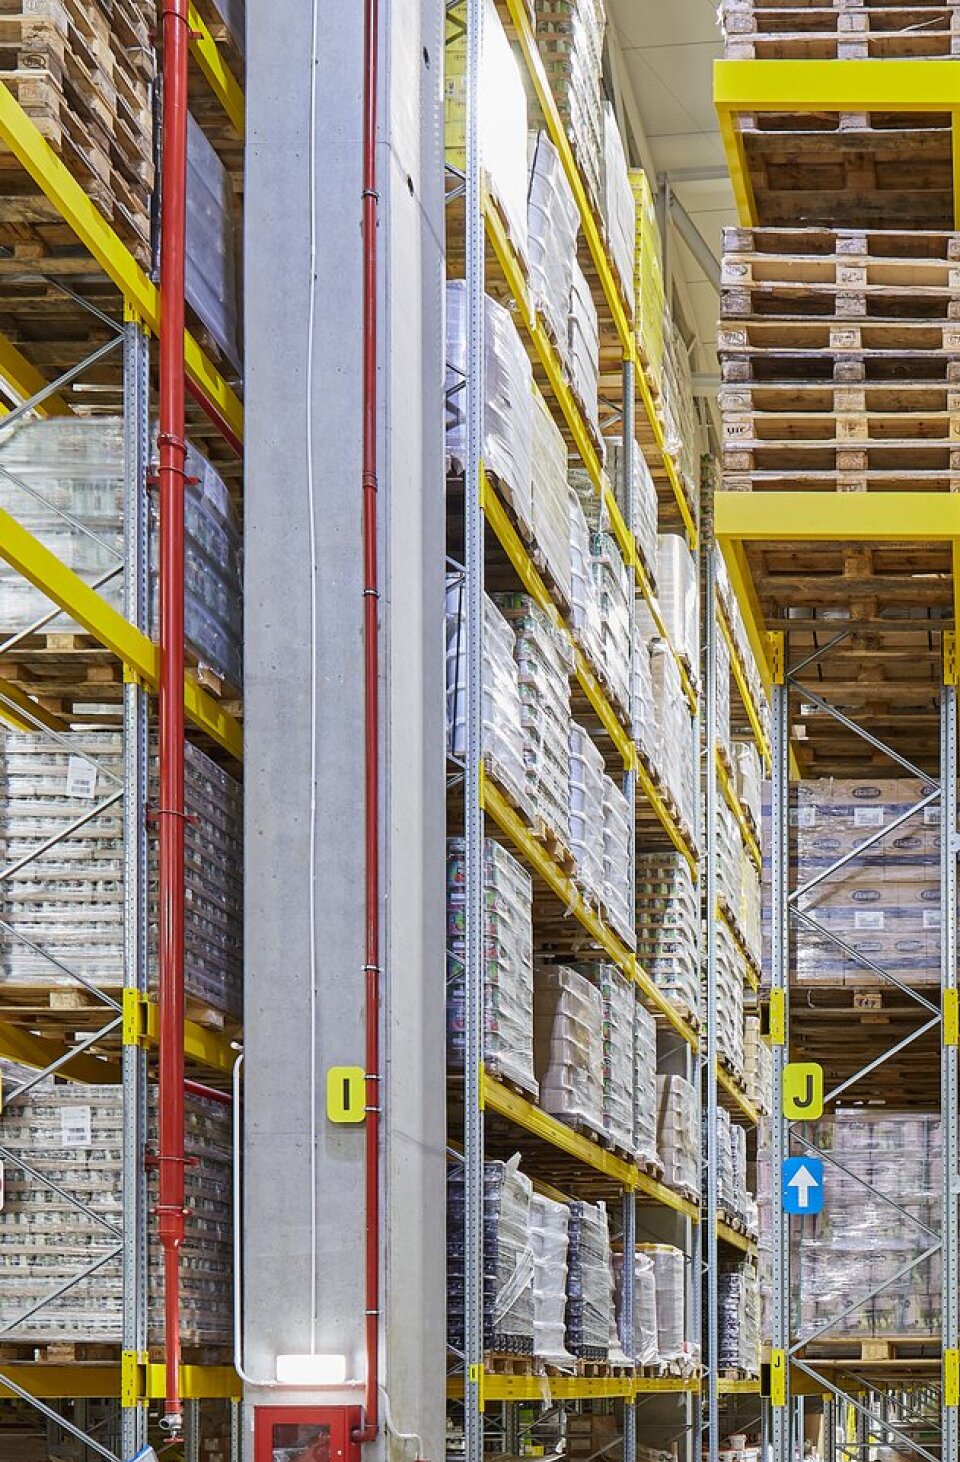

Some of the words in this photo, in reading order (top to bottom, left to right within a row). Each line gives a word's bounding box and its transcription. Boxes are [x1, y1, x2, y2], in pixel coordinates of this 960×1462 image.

[343, 1079, 350, 1110] I
[793, 1075, 813, 1107] J
[775, 1356, 780, 1367] J
